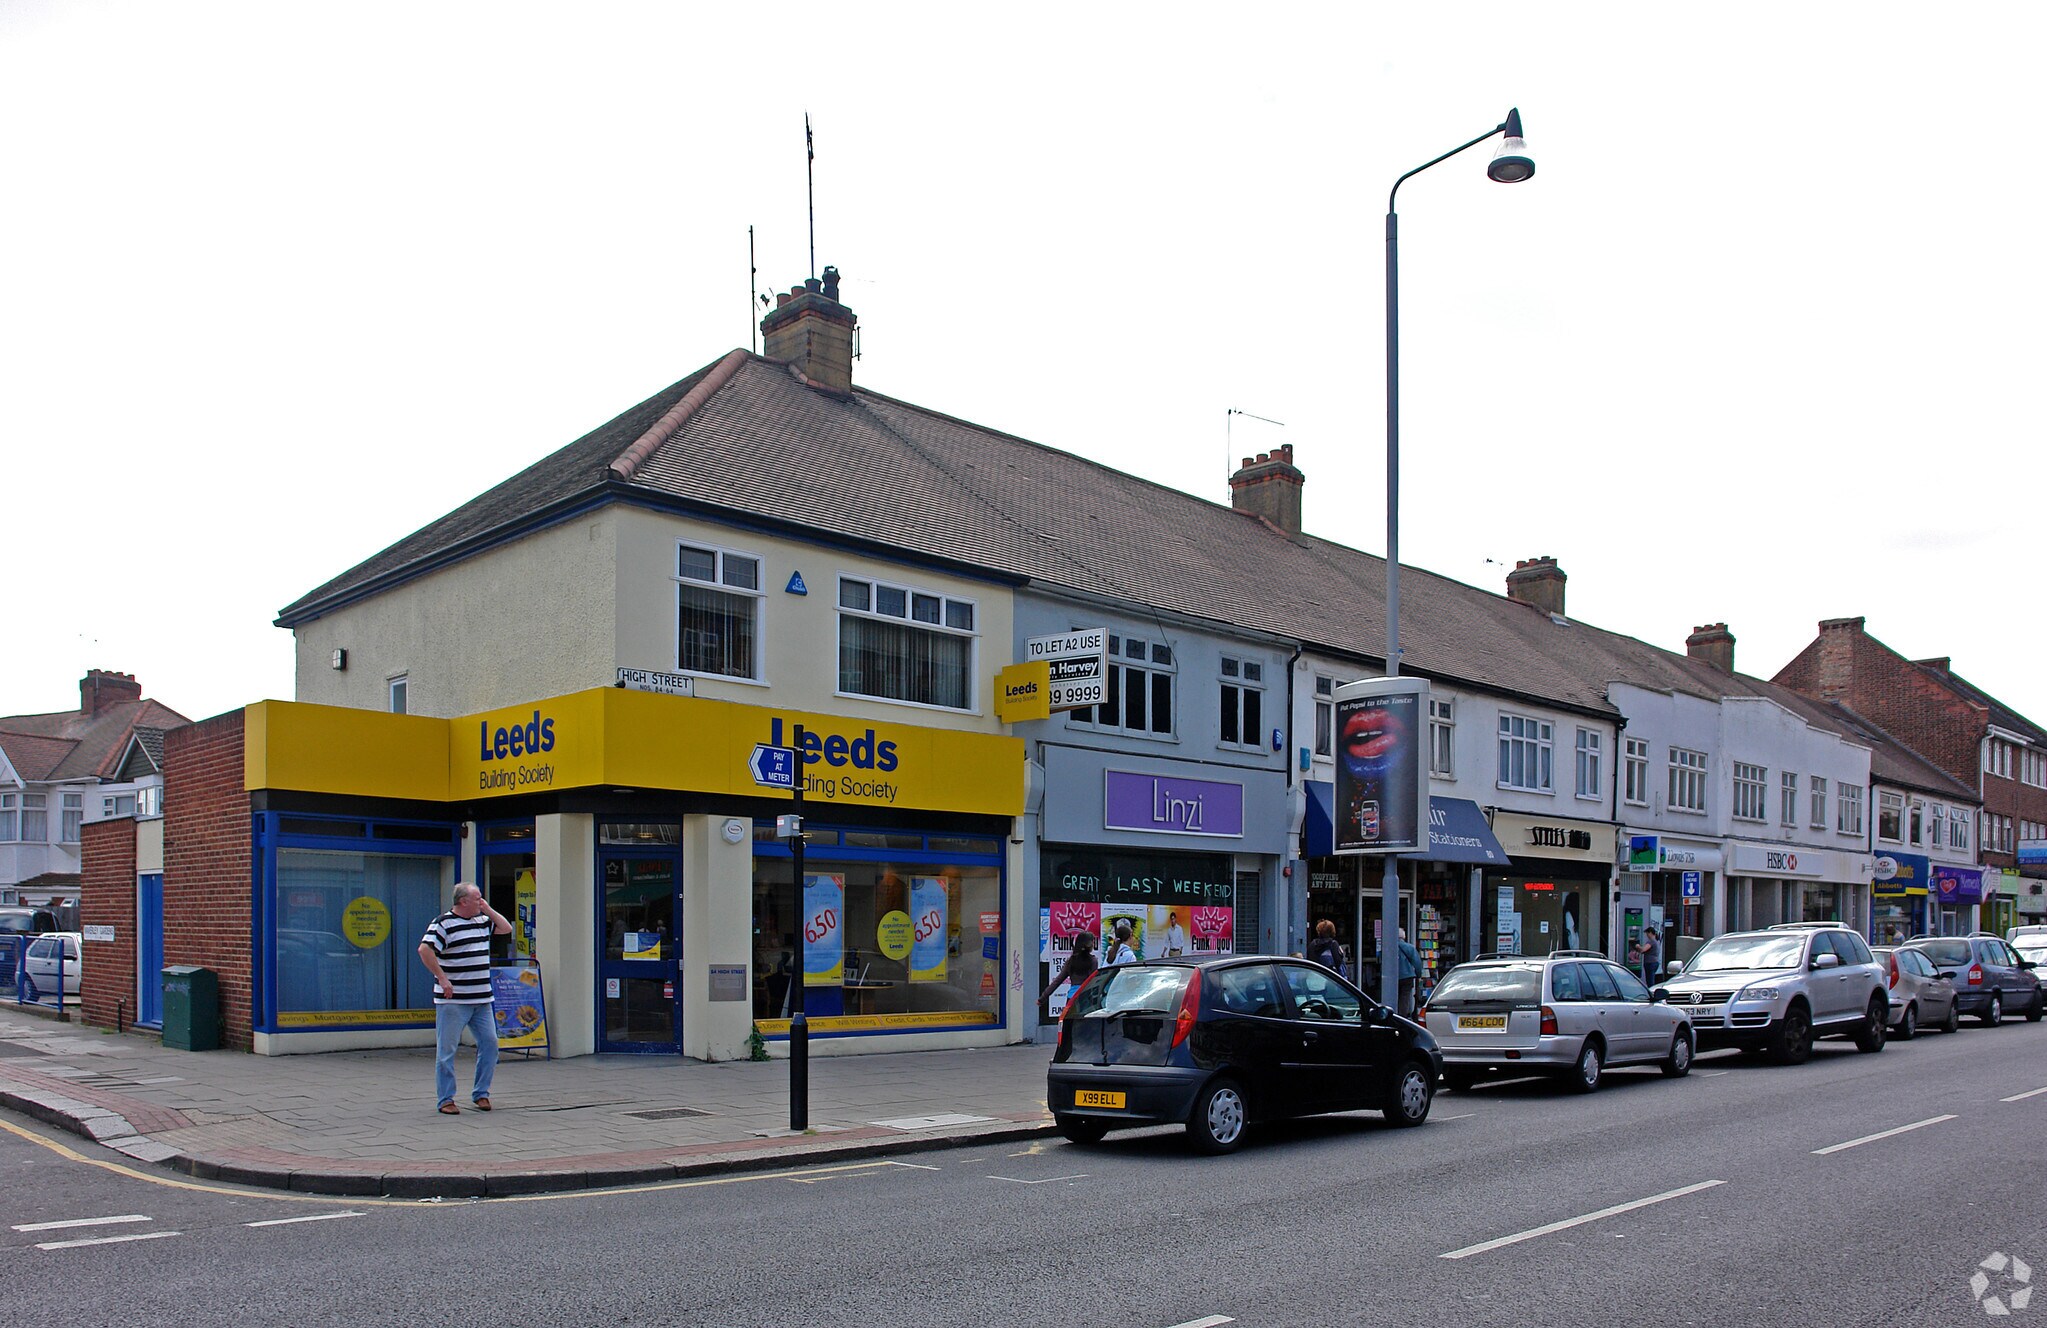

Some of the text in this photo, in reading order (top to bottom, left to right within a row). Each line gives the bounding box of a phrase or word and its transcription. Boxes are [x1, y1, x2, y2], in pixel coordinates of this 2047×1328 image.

[1030, 635, 1101, 655] TO LET A2 USE
[1059, 662, 1098, 677] Harvey
[622, 670, 689, 688] HIGH STREET
[1006, 682, 1027, 697] Leeds
[1066, 685, 1101, 702] 9999
[481, 710, 555, 761] Leeds
[773, 751, 785, 761] PAY
[775, 763, 784, 771] AT
[480, 764, 555, 791] Building Society
[768, 771, 790, 783] METER
[840, 776, 898, 803] Society
[1153, 778, 1203, 831] Linzi
[1428, 831, 1483, 848] Stationers
[1667, 849, 1696, 866] Lloyds TSB
[1767, 852, 1788, 870] HSBC
[1062, 875, 1232, 898] GREAT LAST WEEKEND
[805, 909, 836, 943] 6.50
[914, 910, 941, 942] 6.50
[314, 1014, 360, 1023] Mortgages
[365, 1010, 410, 1020] Investment
[885, 1010, 988, 1024] Credit Cards Investment Planning
[1696, 1007, 1711, 1015] NRY
[762, 1022, 783, 1030] Loans
[849, 1018, 876, 1026] Writing
[1460, 1017, 1483, 1026] W664
[1082, 1093, 1117, 1105] X99 ELL
